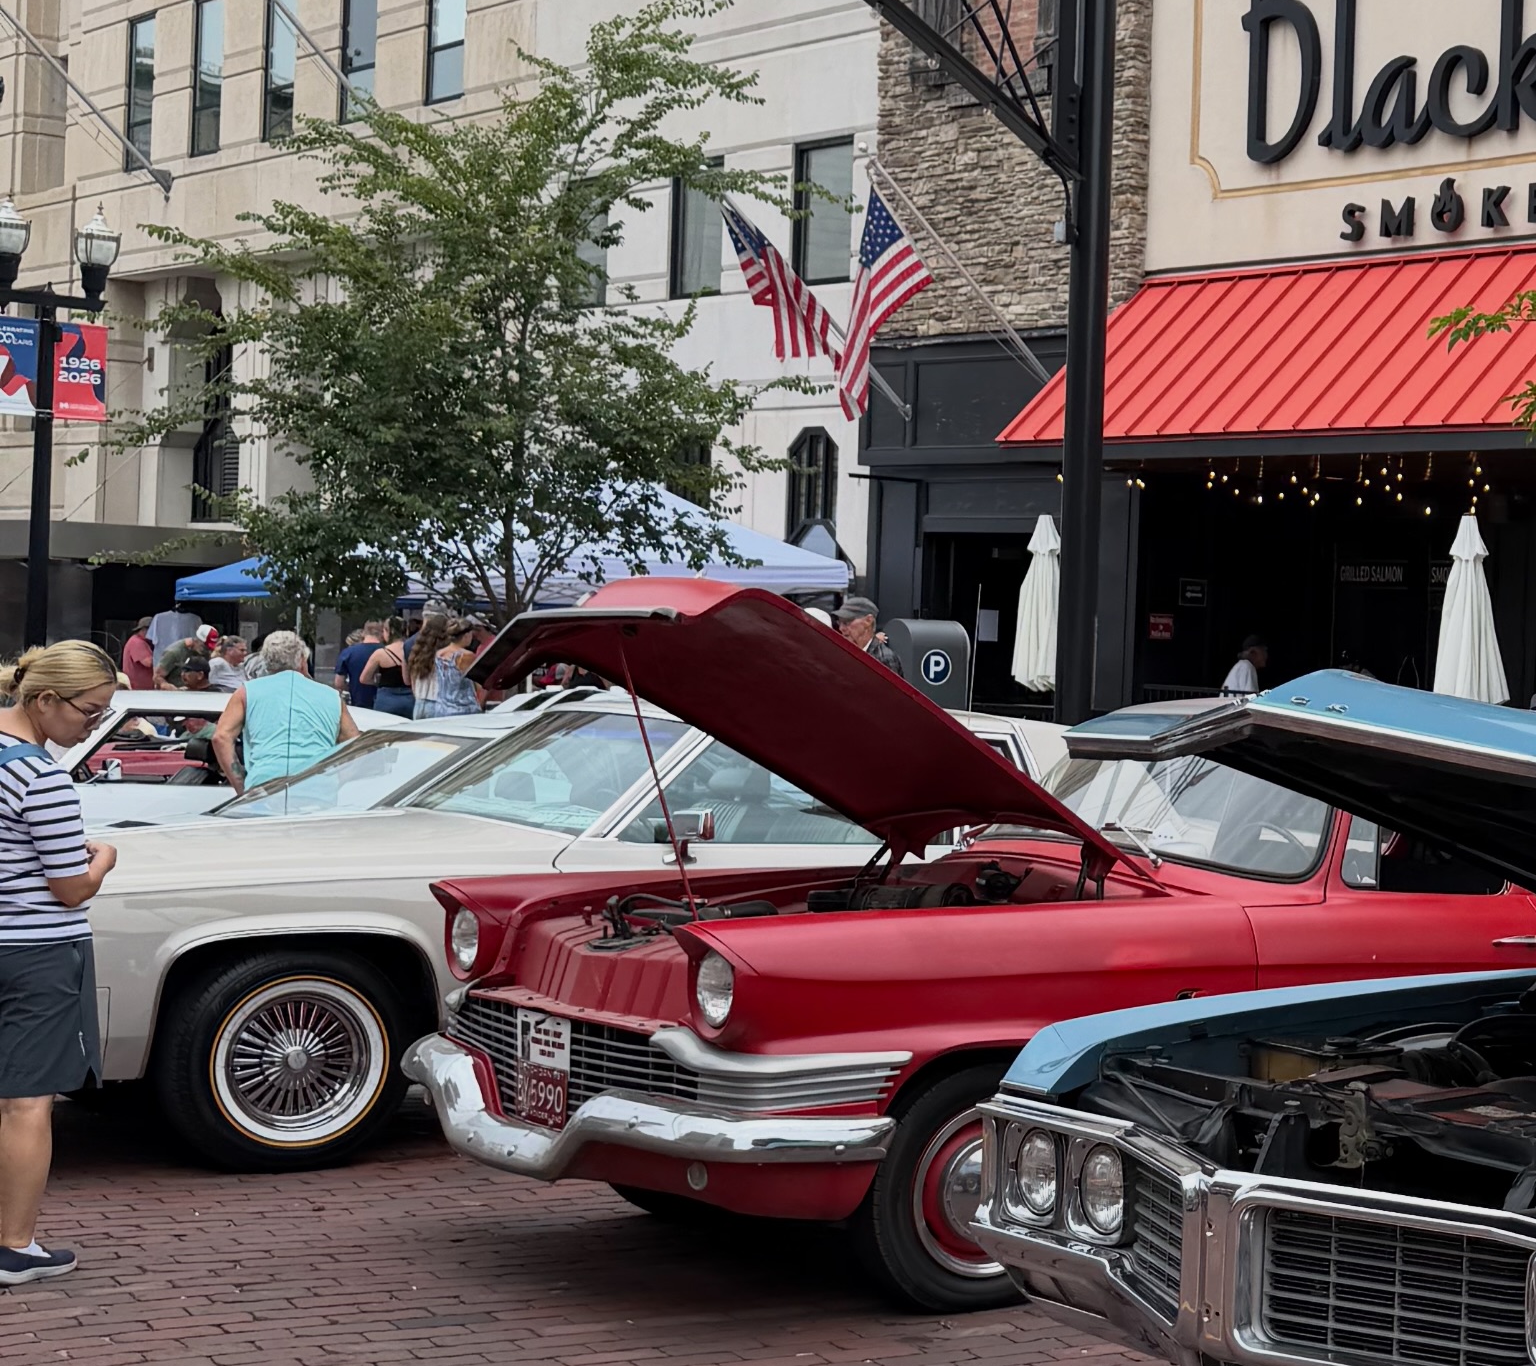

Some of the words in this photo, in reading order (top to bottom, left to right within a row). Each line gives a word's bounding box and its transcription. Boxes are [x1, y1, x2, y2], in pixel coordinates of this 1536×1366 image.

[59, 356, 101, 370] 1926
[58, 370, 101, 385] 2026
[1340, 566, 1370, 582] GRILLED
[1371, 566, 1404, 583] SALMON
[930, 655, 946, 680] P
